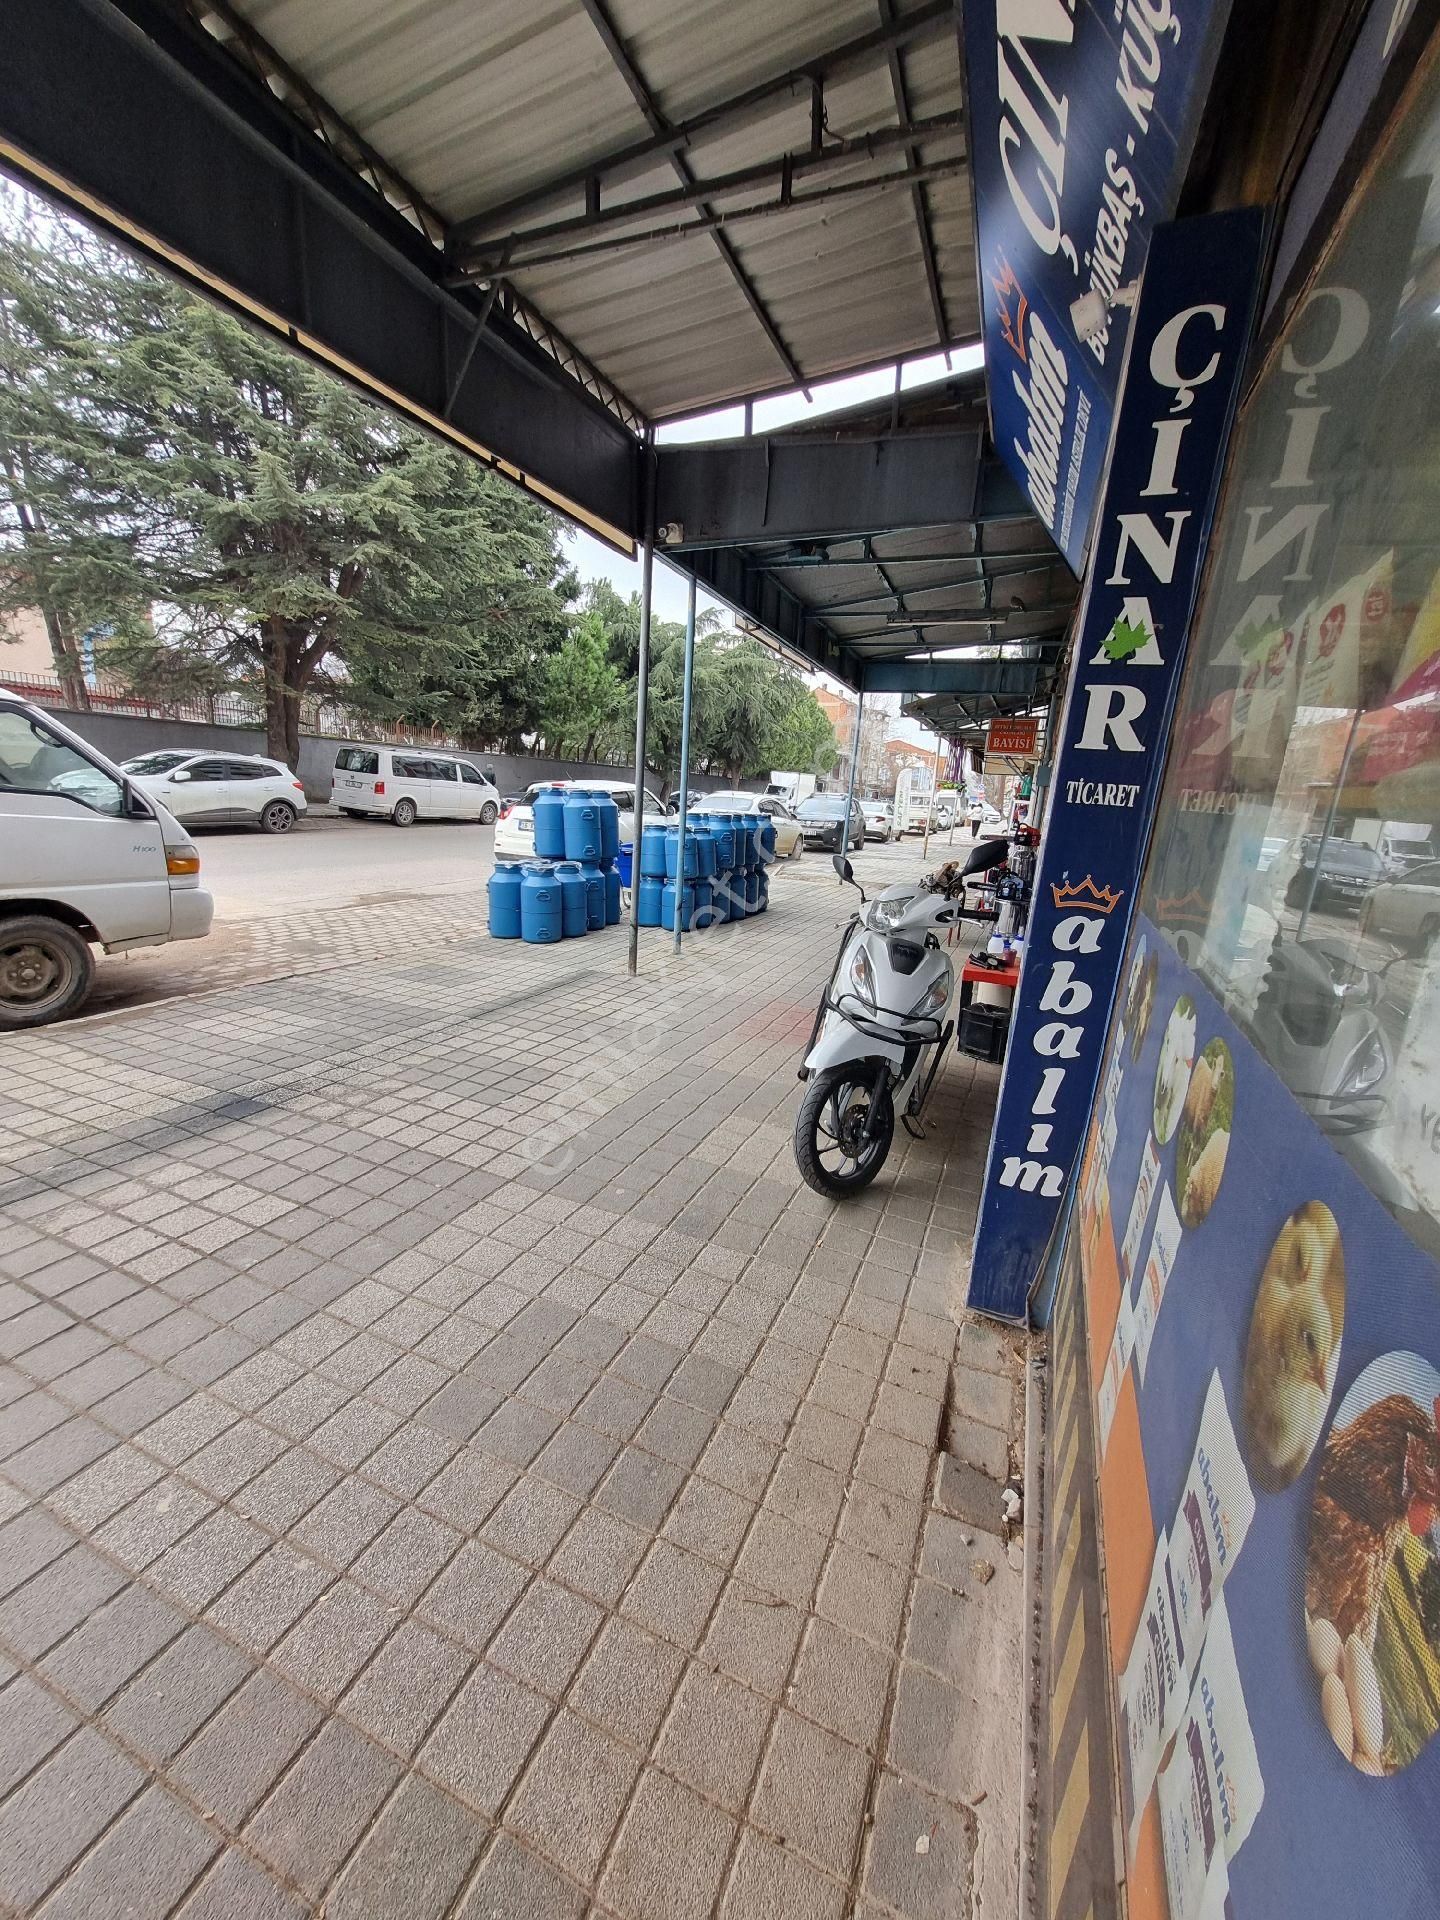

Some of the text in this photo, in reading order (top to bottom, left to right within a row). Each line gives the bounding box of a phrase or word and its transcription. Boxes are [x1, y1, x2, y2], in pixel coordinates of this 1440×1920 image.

[1084, 148, 1146, 366] BÜKBAŞ
[993, 736, 1031, 750] BAYİSİ
[1067, 776, 1141, 808] TİCARET
[998, 914, 1105, 1198] abalım
[1201, 1676, 1232, 1839] abalım
